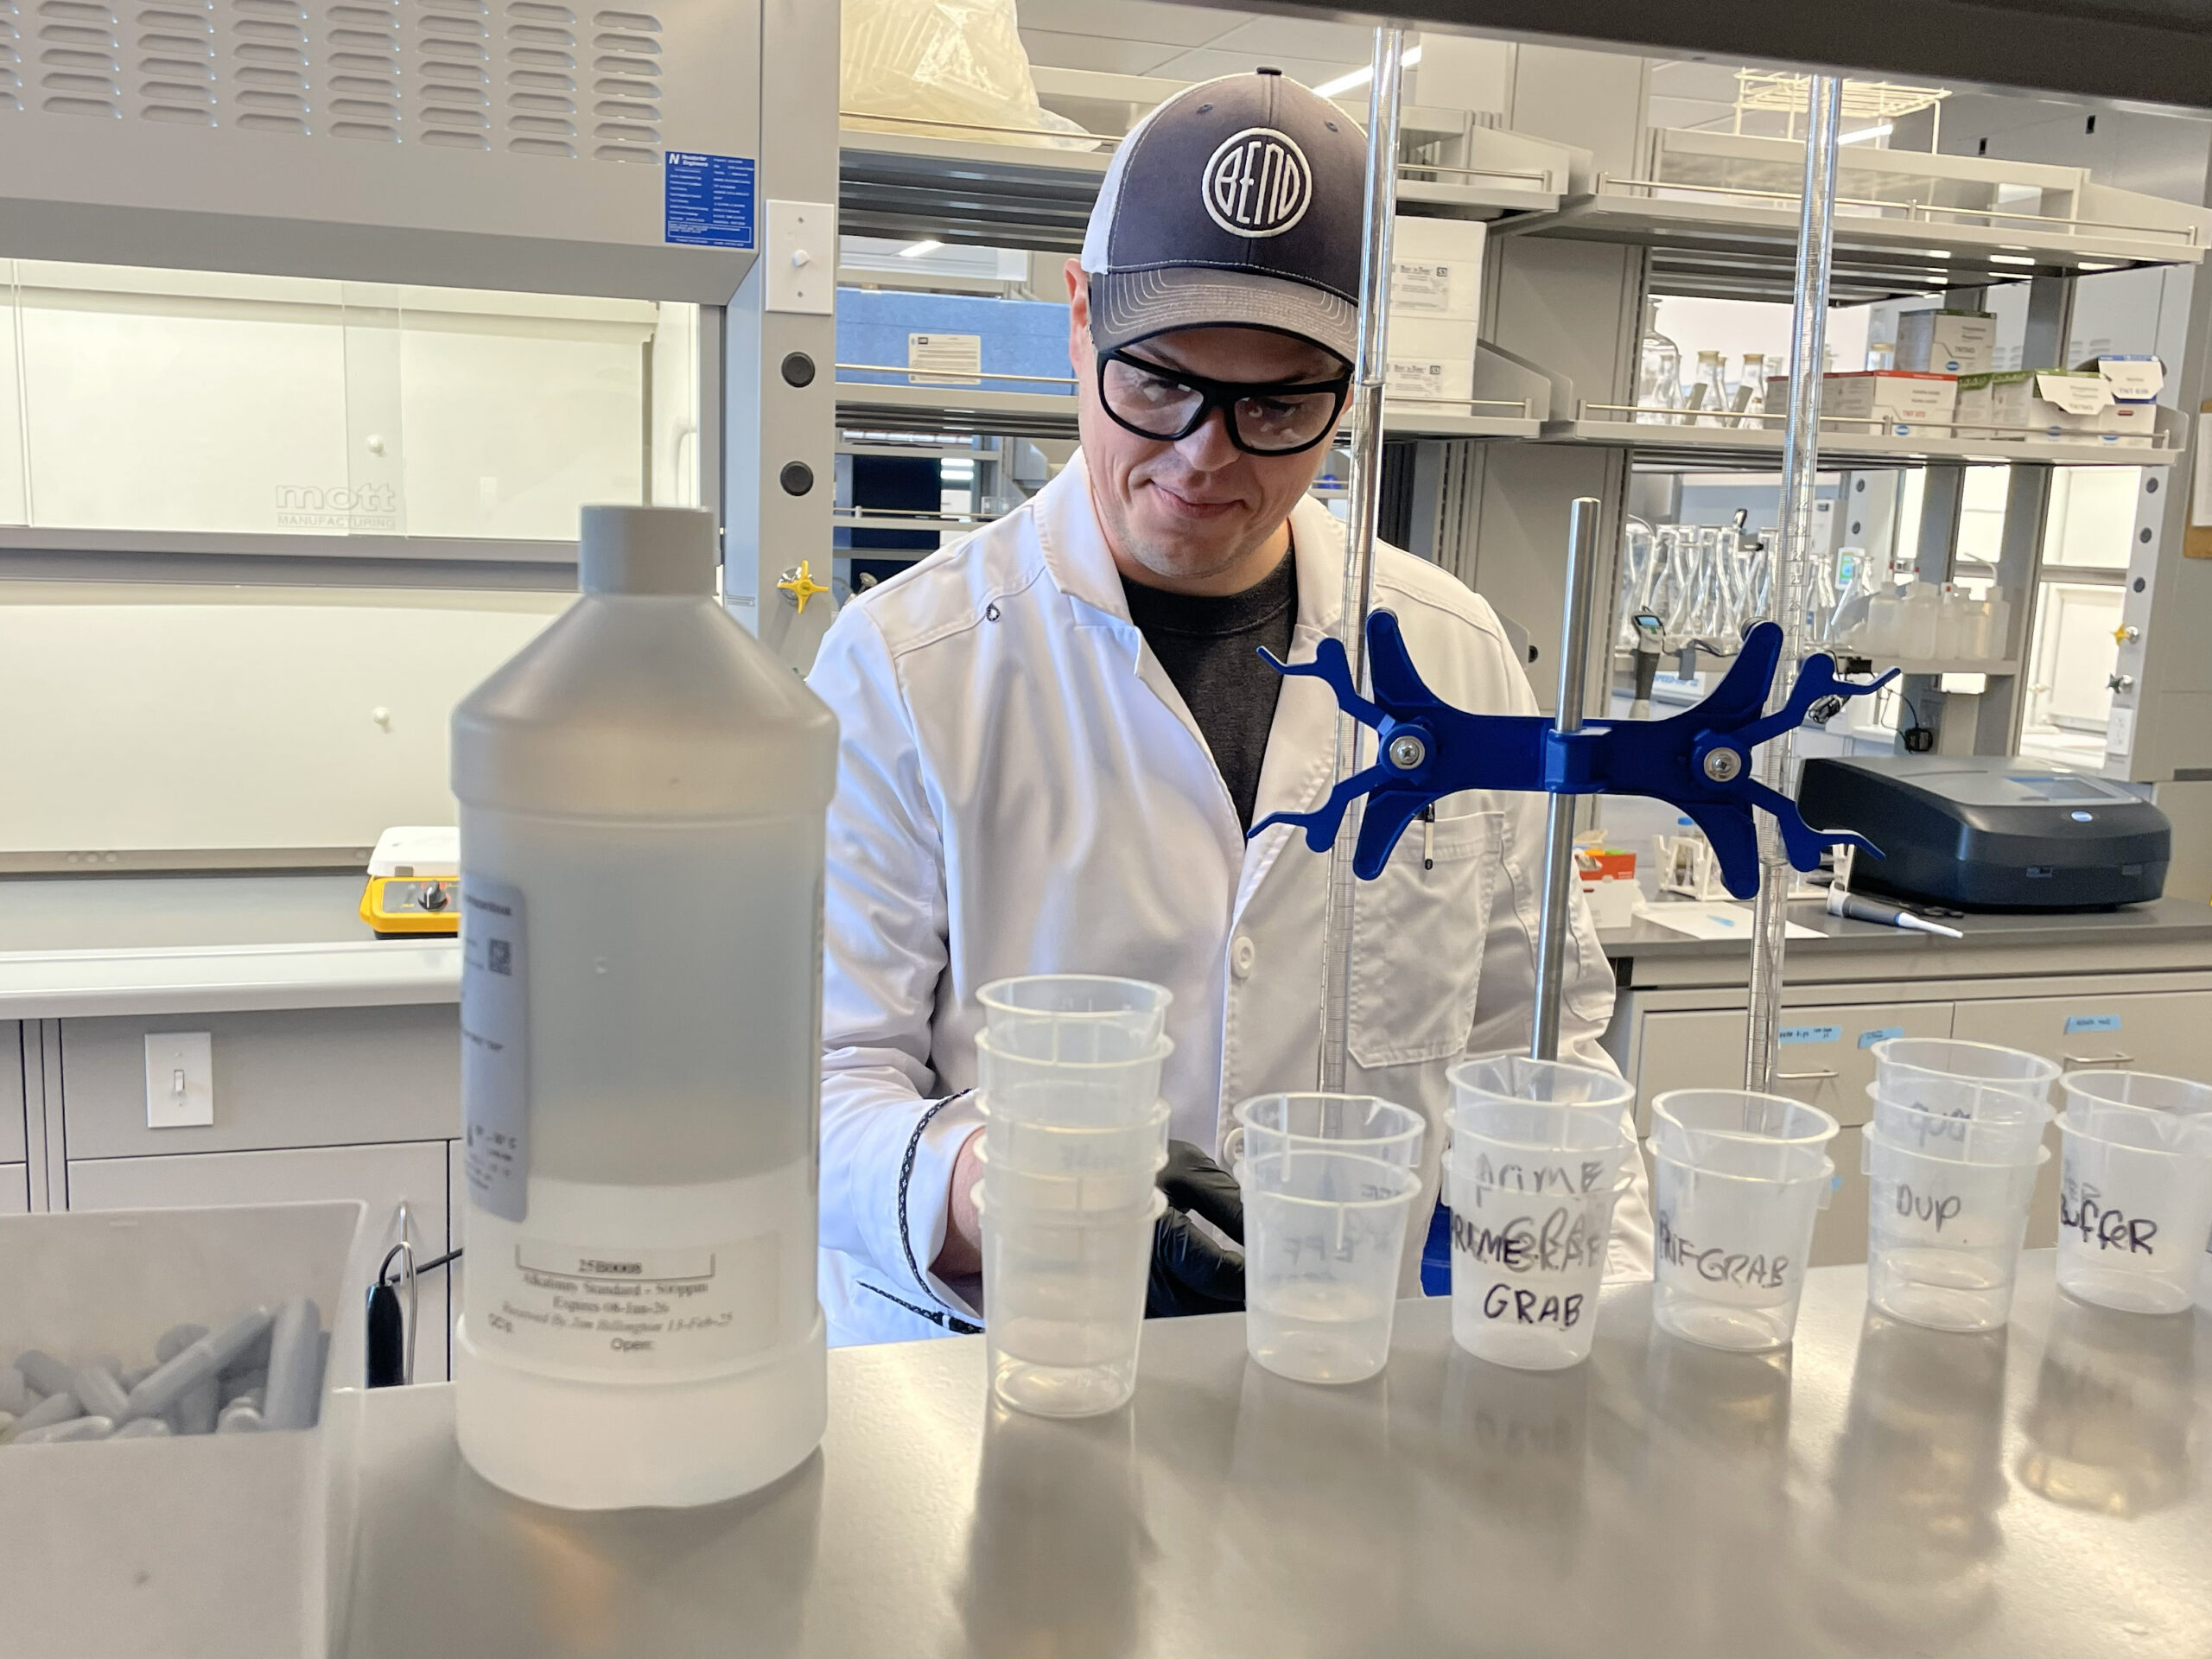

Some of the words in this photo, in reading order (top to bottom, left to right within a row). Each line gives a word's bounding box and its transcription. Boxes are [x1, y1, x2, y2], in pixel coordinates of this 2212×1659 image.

[1215, 141, 1300, 225] BEND
[275, 483, 395, 512] mott
[276, 514, 395, 529] MANUFACTURING
[1484, 1282, 1584, 1332] GRAB
